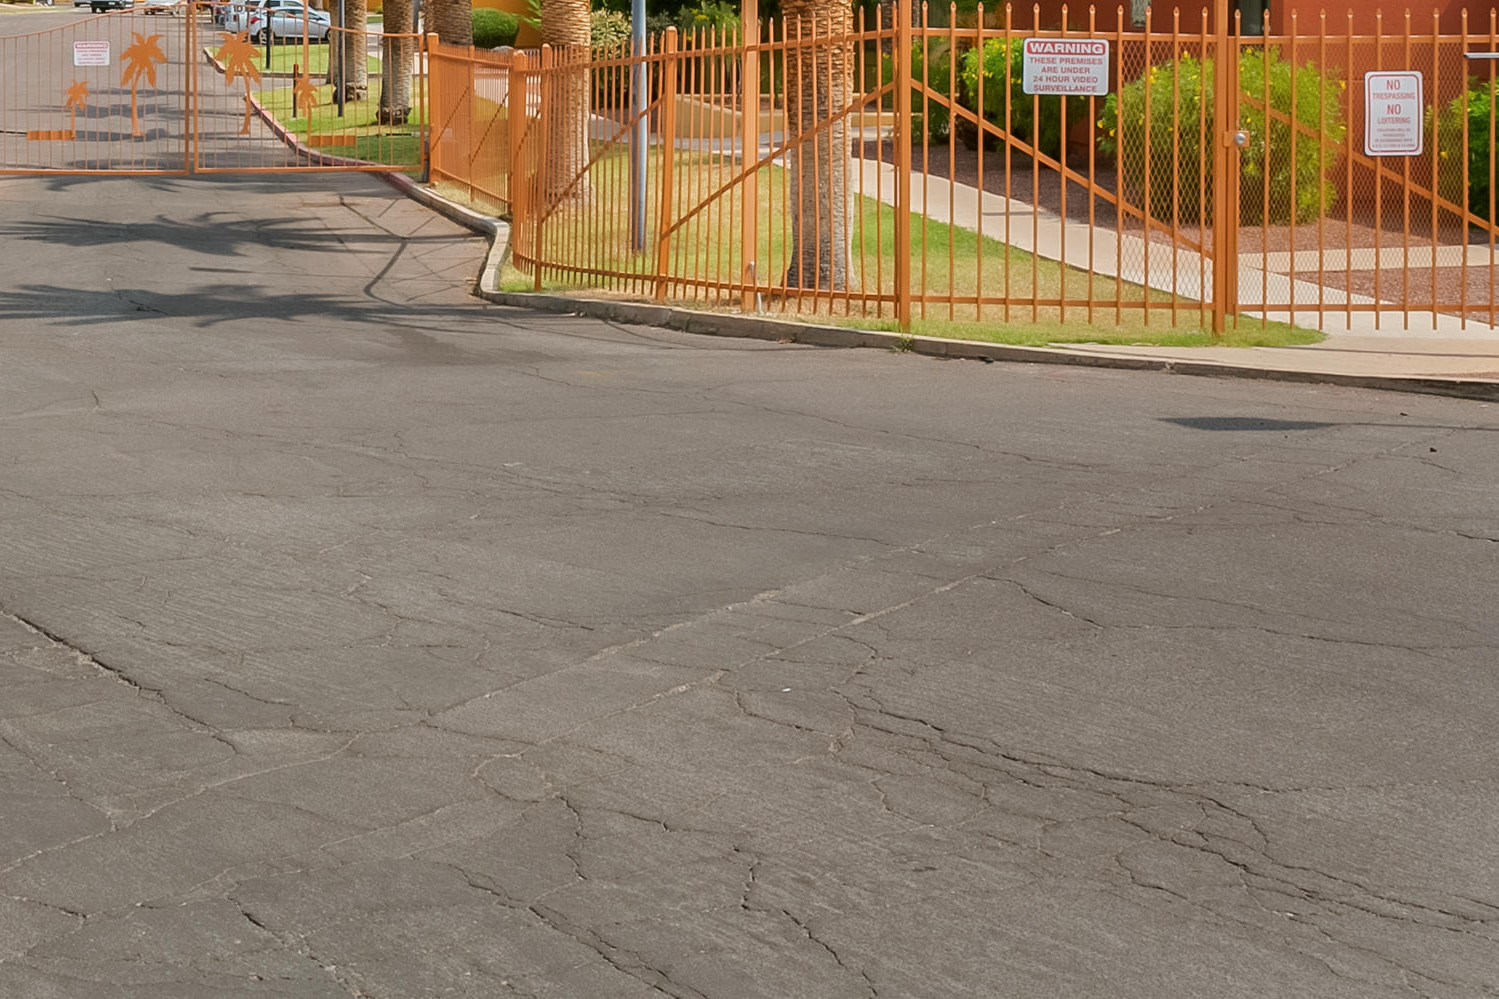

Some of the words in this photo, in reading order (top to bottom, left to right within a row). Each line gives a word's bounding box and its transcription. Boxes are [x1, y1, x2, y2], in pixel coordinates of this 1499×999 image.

[1029, 42, 1104, 54] WARNING
[1386, 80, 1400, 90] NO
[1387, 104, 1402, 114] NO
[1377, 116, 1411, 124] LOITERING
